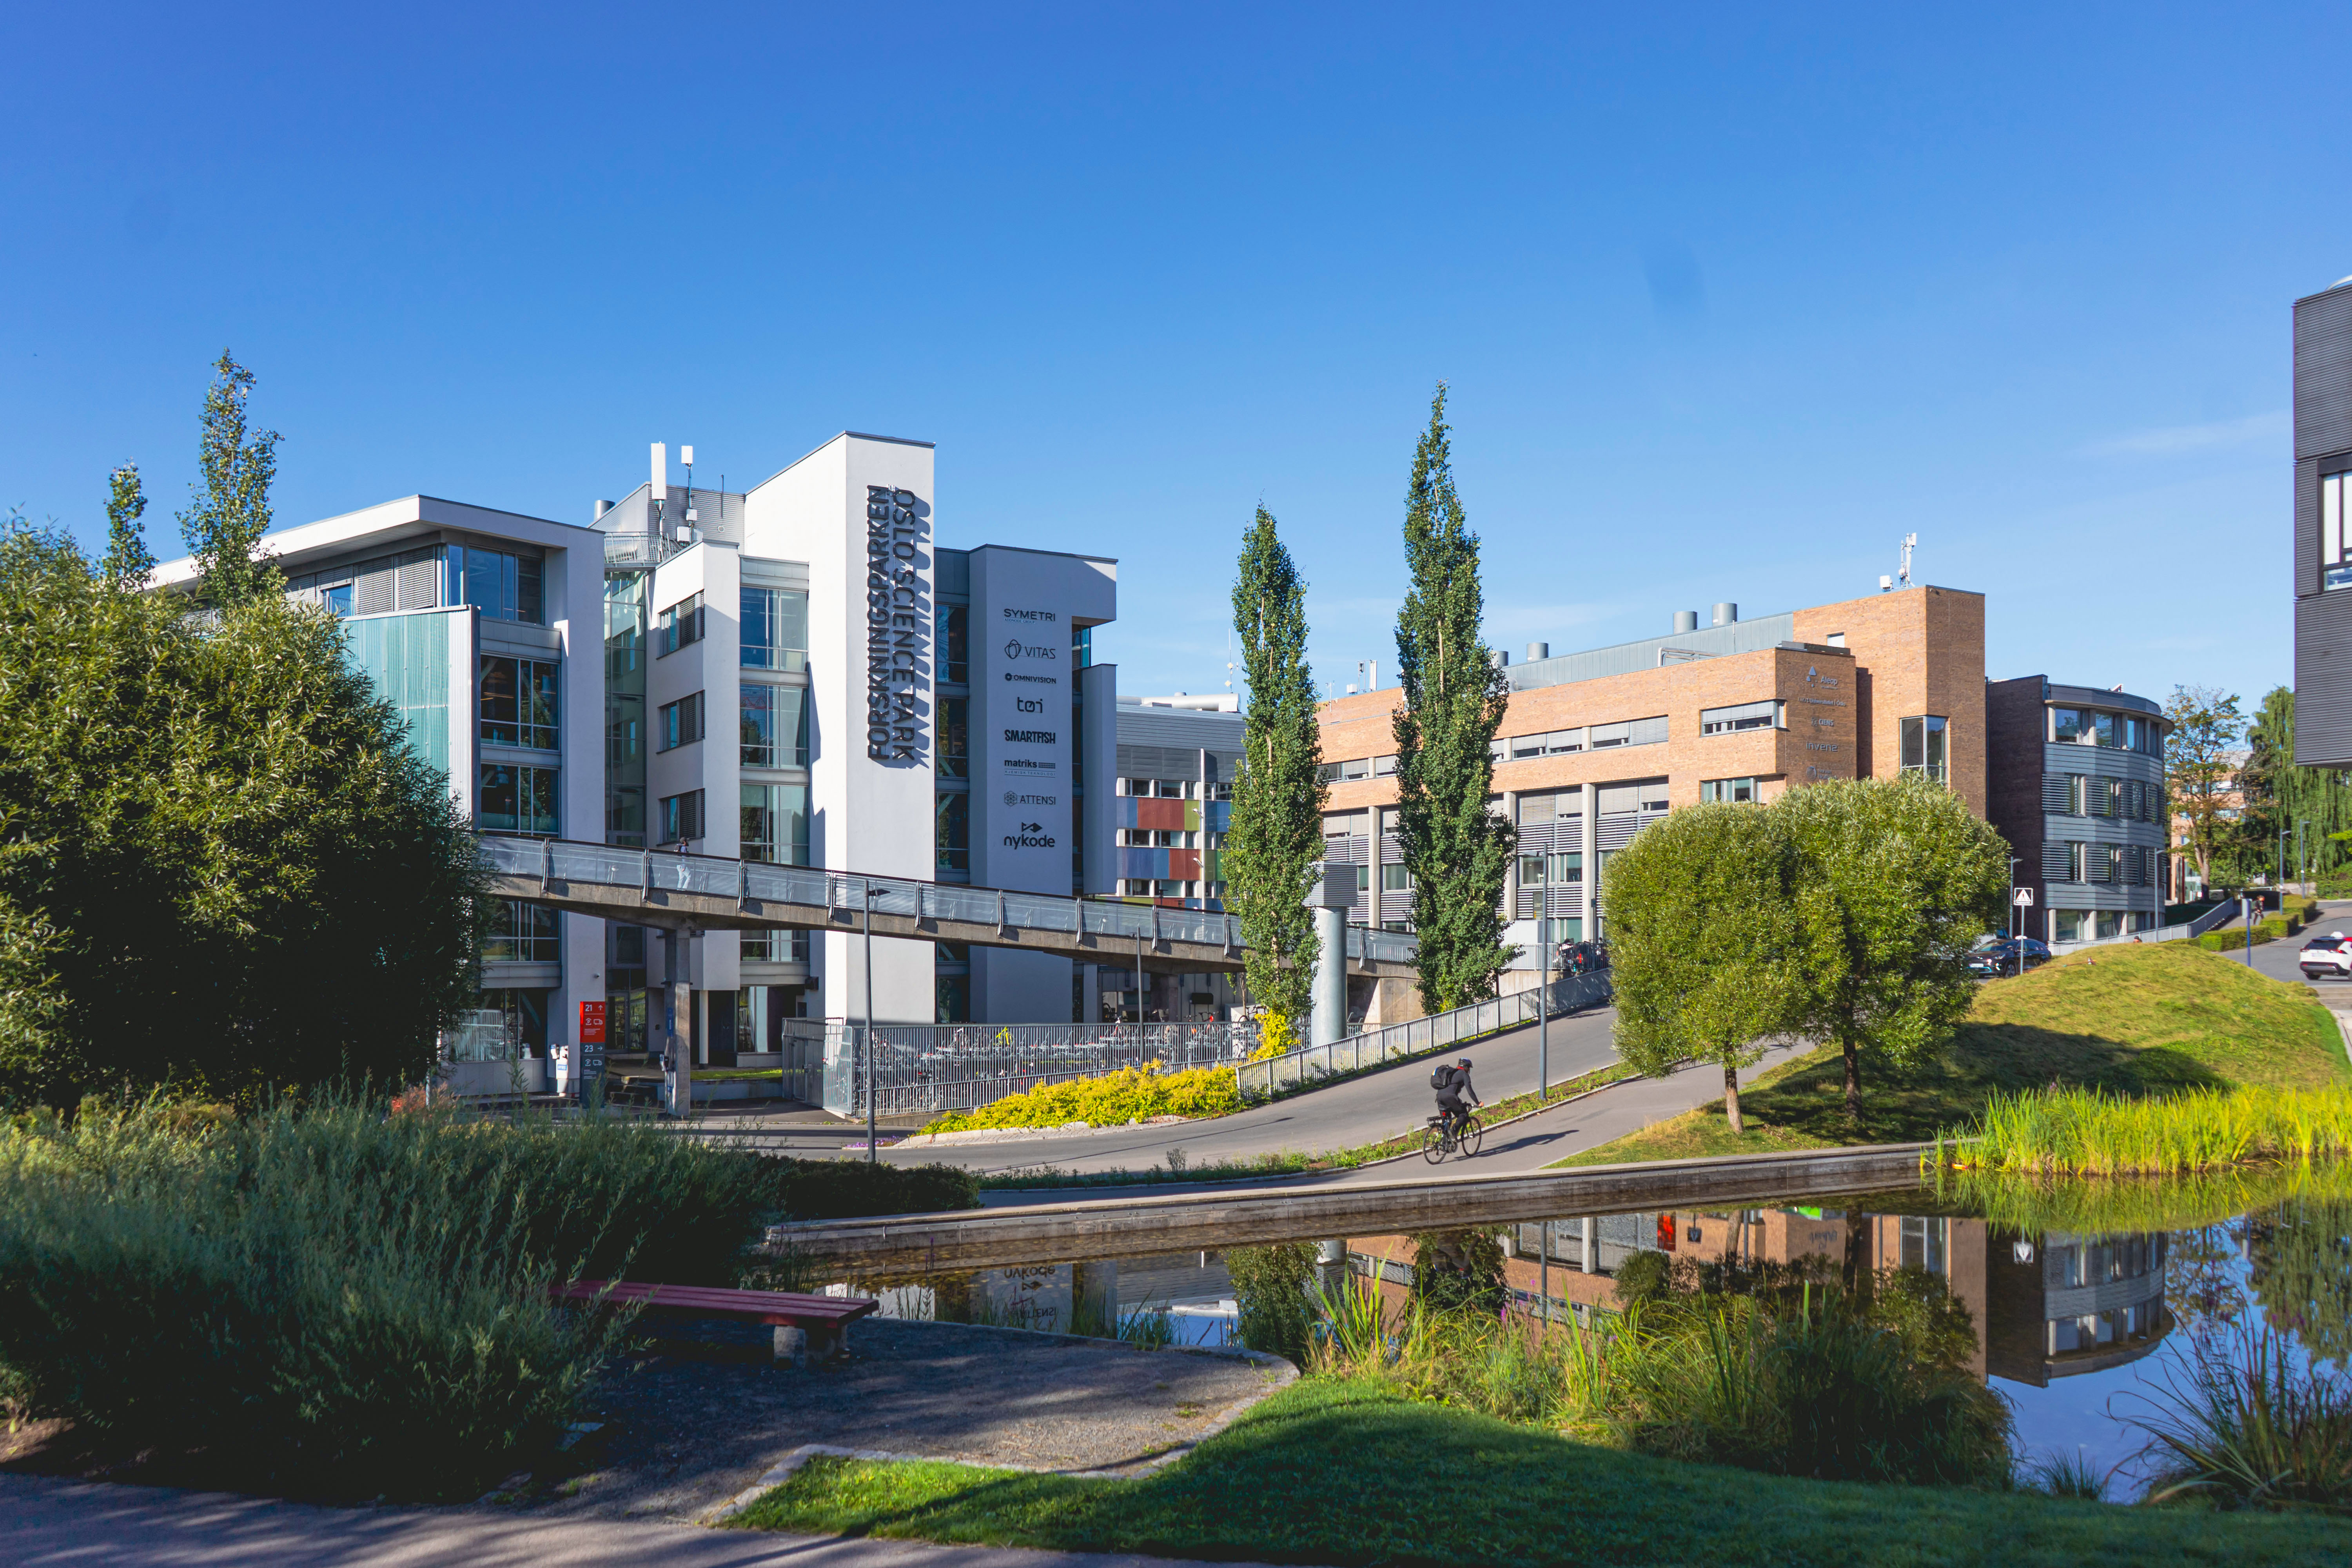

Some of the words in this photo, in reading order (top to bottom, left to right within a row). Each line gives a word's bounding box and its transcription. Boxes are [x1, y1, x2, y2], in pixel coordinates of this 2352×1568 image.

[893, 489, 916, 559] OSLO
[1004, 608, 1055, 621] SYMETRI
[867, 485, 889, 759] FORSKNINGSPARKEN
[893, 568, 915, 682] SCIENCE
[1025, 646, 1056, 659] VITAS
[1014, 674, 1056, 684] OMNIVISION
[1820, 676, 1838, 686] Aleap
[893, 692, 915, 760] PARK
[1004, 730, 1056, 744] SMARTFISH
[1004, 759, 1037, 768] matriks
[1020, 795, 1056, 805] ATTENSI
[1004, 834, 1055, 849] nykode
